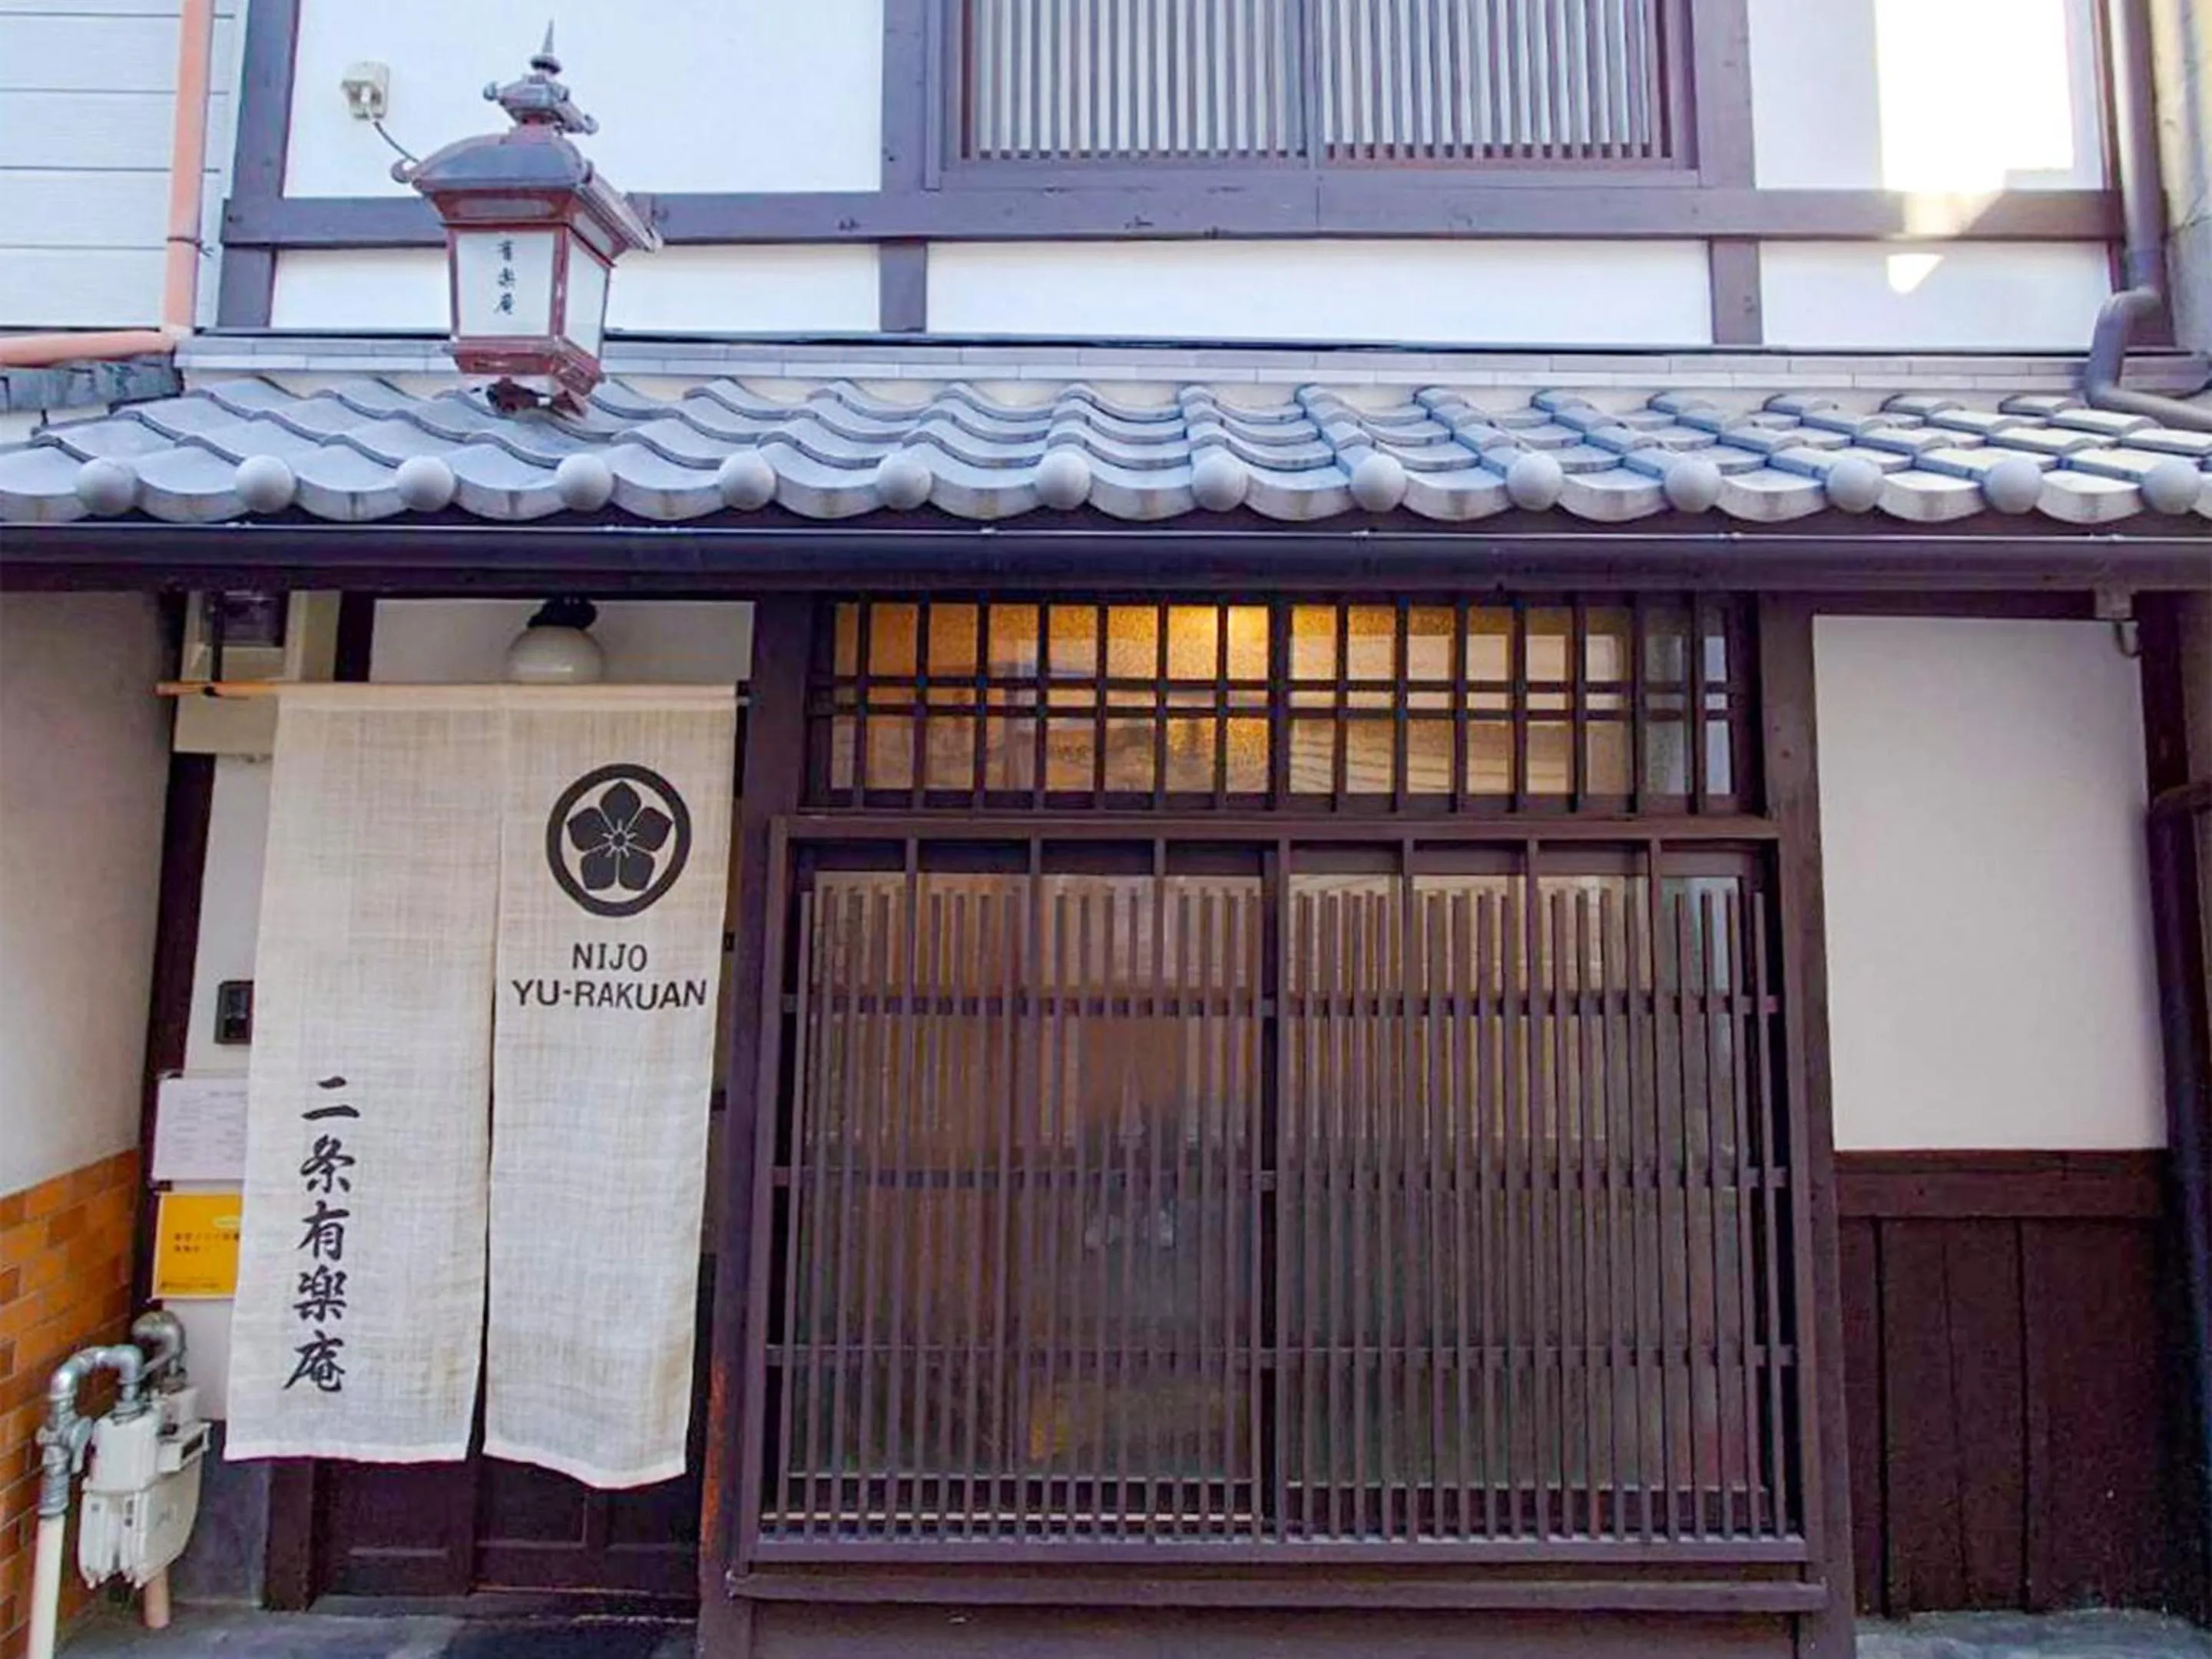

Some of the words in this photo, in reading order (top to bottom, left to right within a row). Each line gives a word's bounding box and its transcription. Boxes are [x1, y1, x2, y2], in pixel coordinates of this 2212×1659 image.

[571, 942, 648, 973] NIJO
[511, 979, 707, 1012] YU-RAKUAN
[282, 1075, 361, 1393] 二条有楽庵
